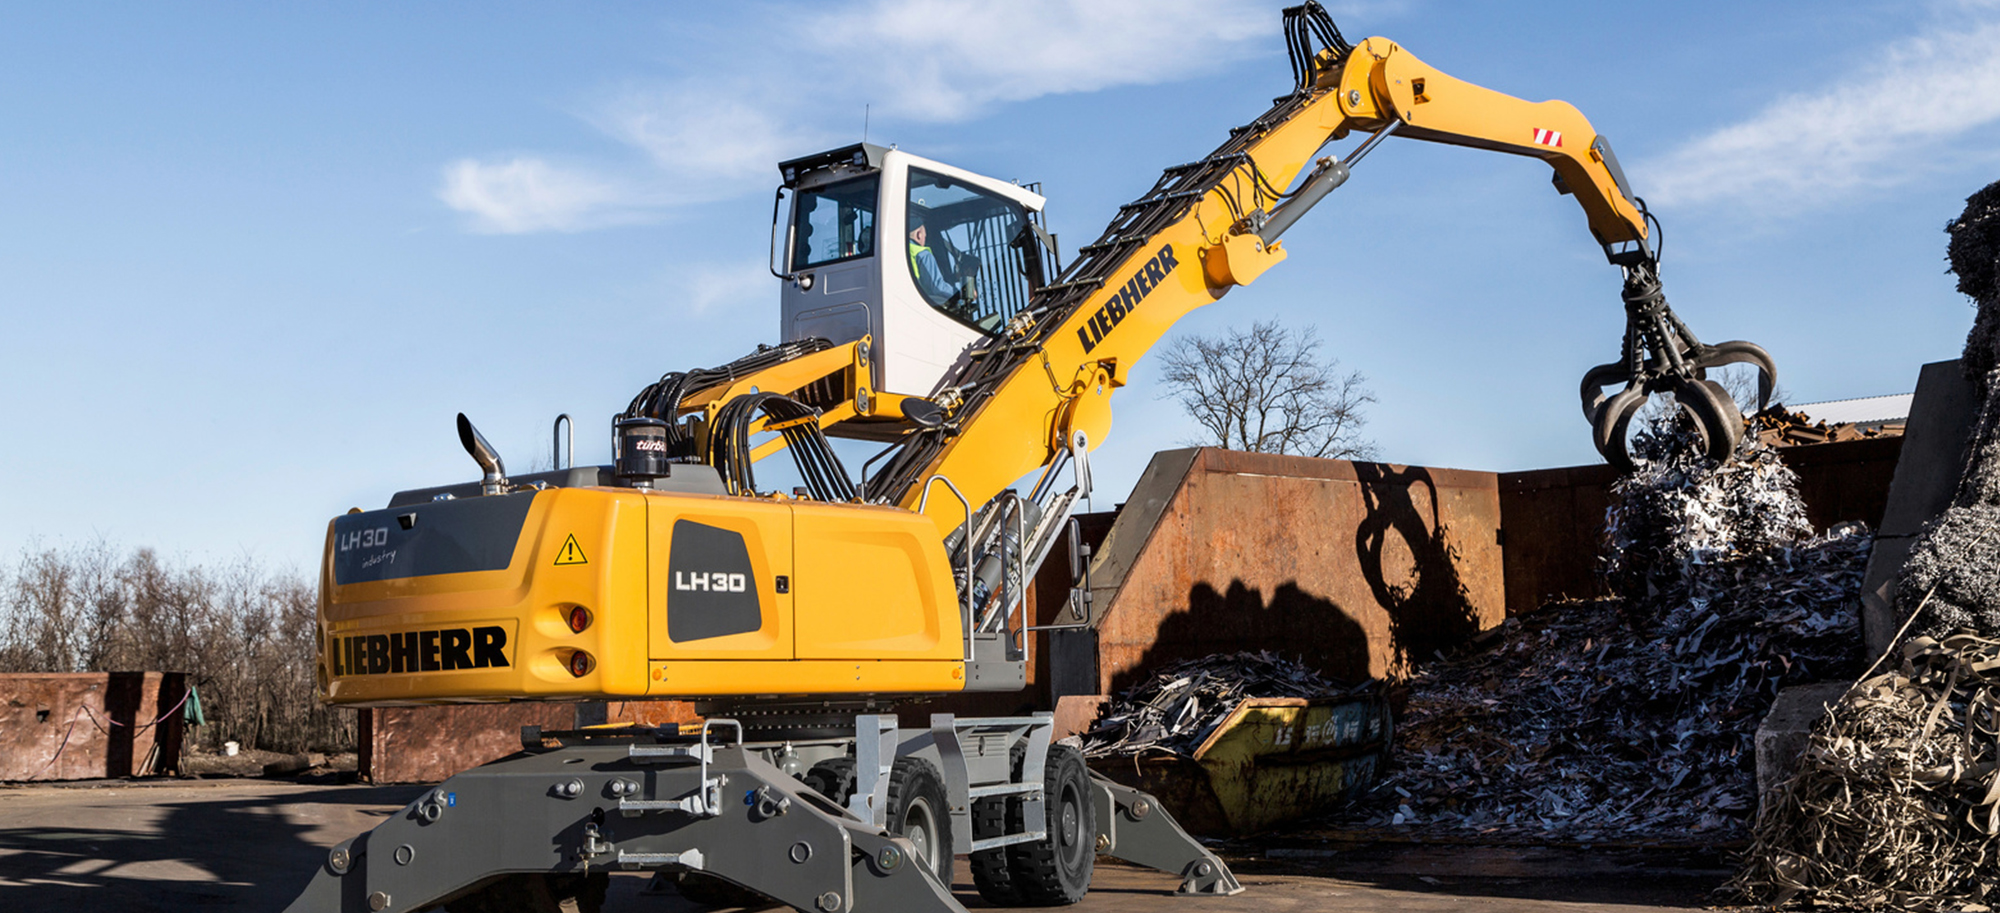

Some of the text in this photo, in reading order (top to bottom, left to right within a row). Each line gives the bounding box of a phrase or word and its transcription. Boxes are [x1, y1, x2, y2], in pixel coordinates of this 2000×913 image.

[1076, 243, 1180, 355] LIEBHERR
[362, 549, 397, 569] industry
[333, 626, 510, 676] LIEBHERR
